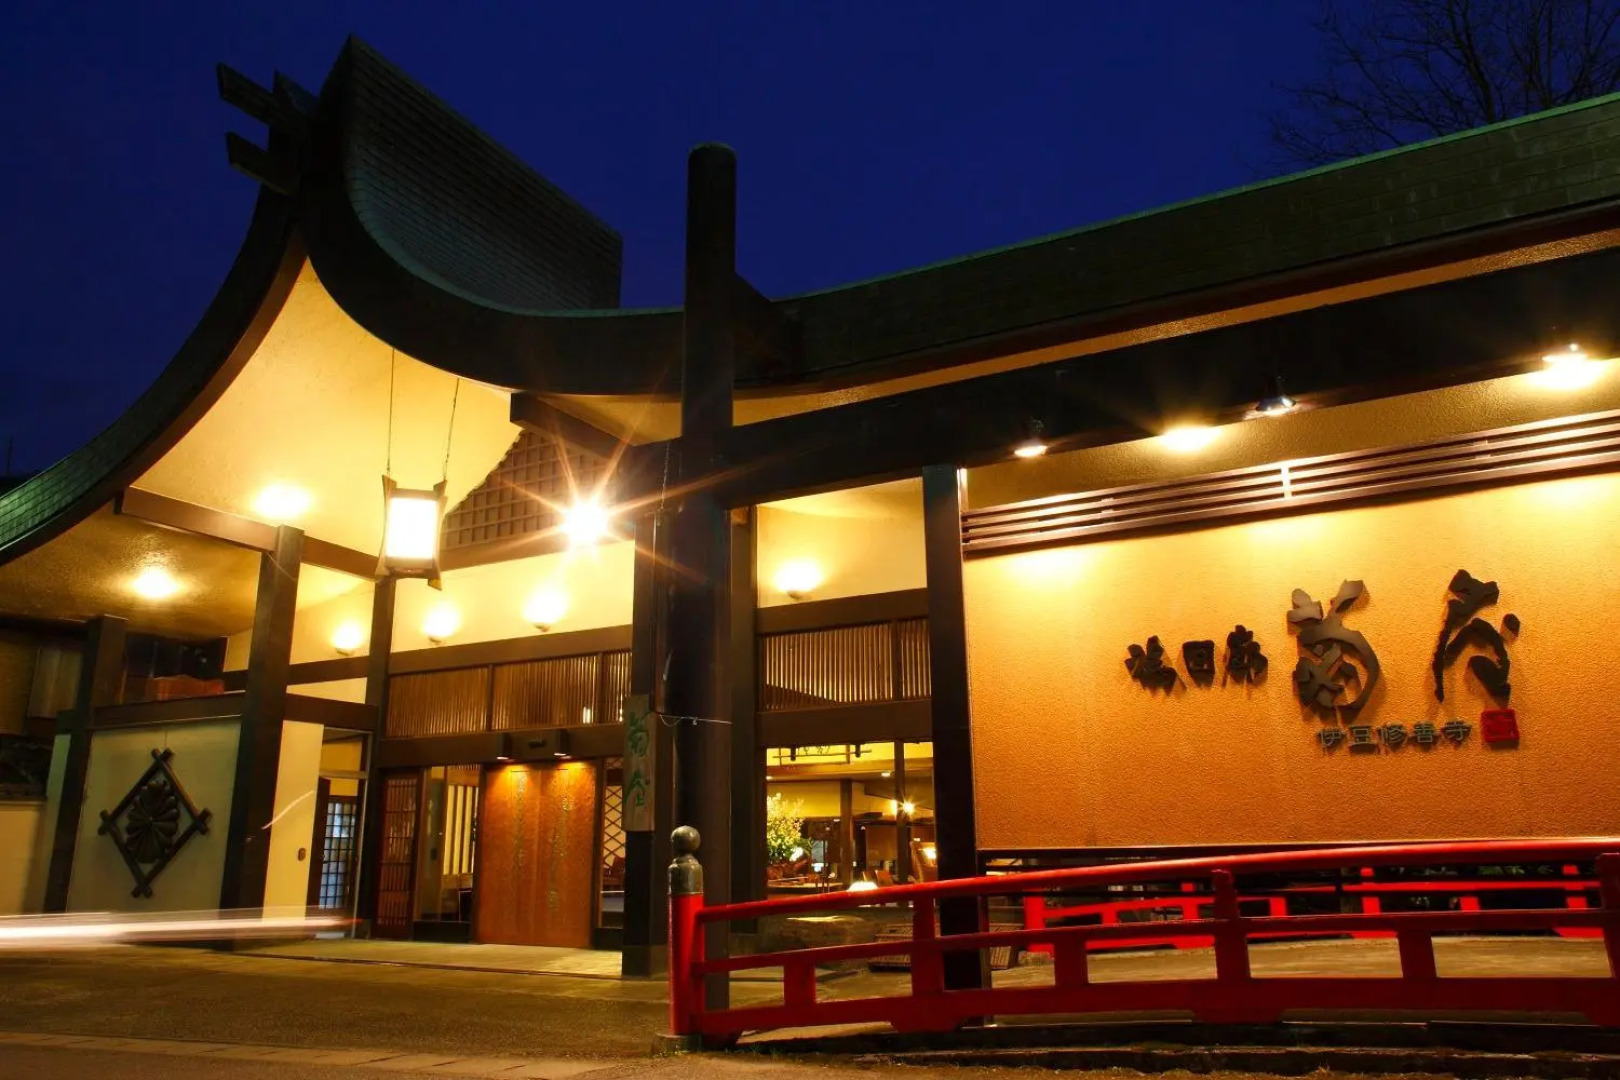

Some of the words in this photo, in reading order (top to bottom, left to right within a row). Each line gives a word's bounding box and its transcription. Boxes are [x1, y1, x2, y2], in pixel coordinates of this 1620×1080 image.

[1318, 720, 1471, 746] 伊豆修善寺
